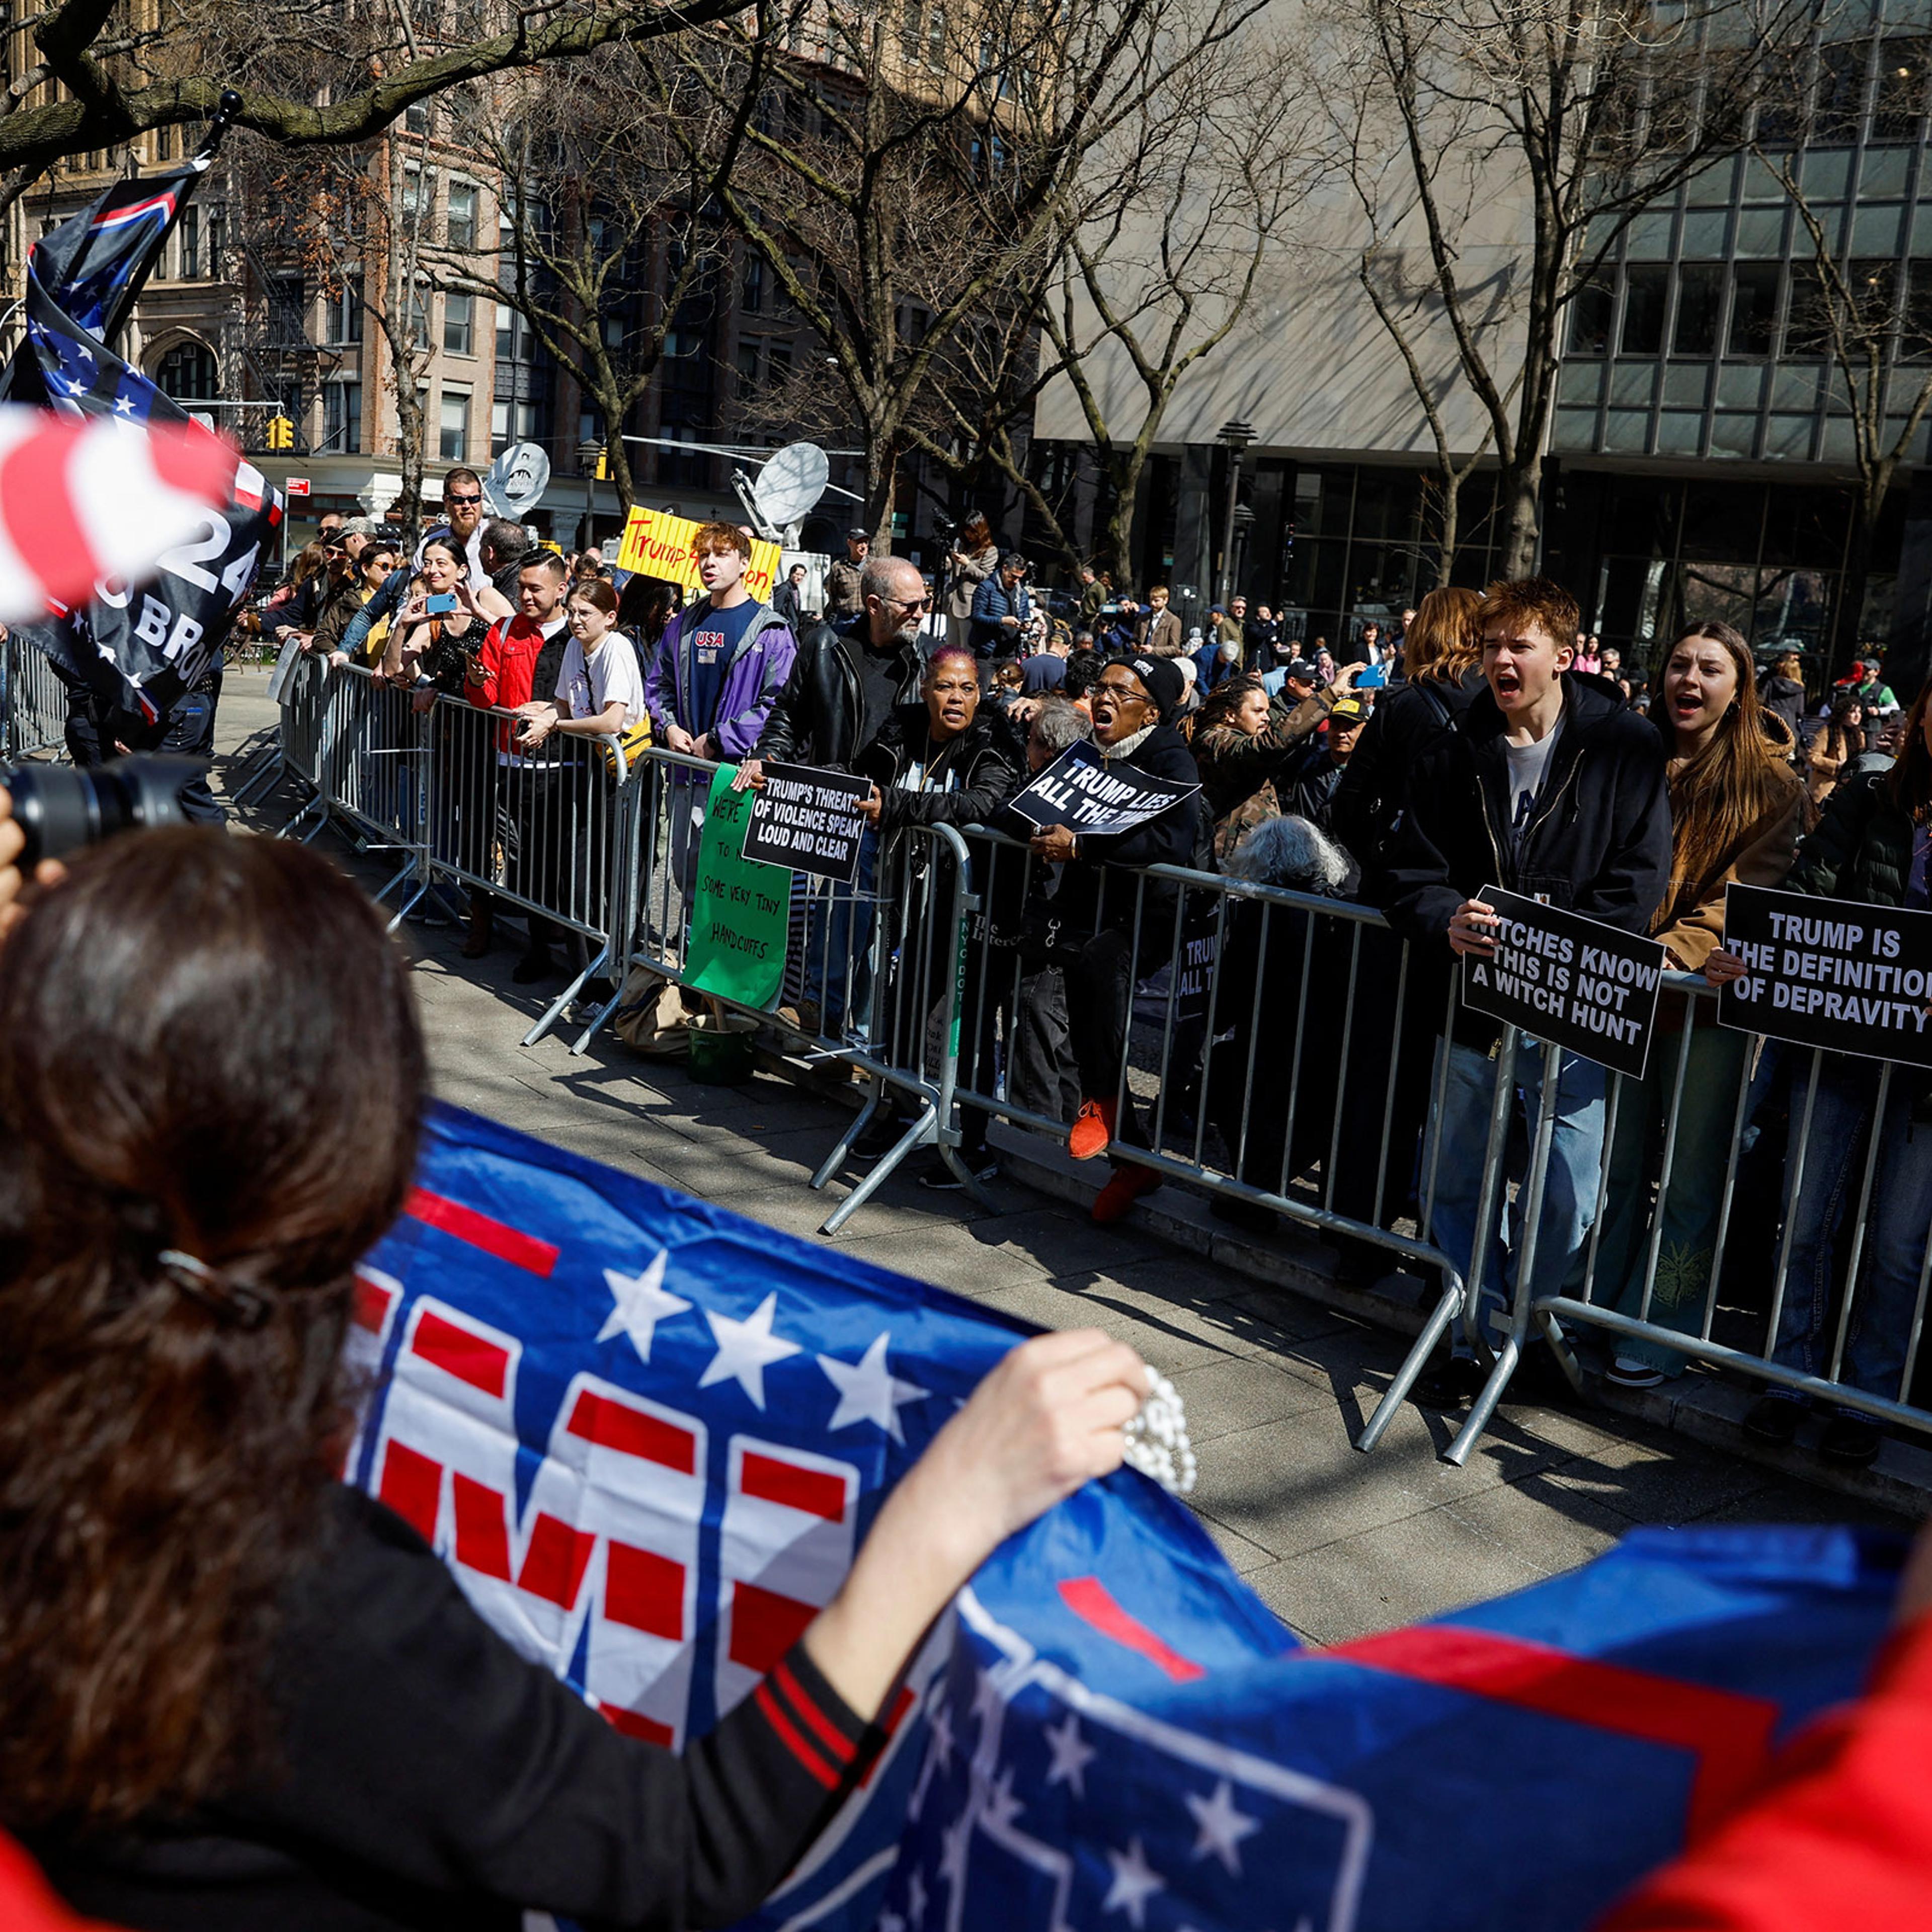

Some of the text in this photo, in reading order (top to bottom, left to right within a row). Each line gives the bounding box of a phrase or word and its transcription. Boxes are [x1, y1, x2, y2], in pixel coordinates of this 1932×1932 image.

[629, 520, 686, 568] Trump
[695, 631, 725, 648] USA
[766, 778, 860, 814] TRUMP'S THREATS
[1029, 775, 1075, 812] ALL
[1072, 797, 1119, 825] THE
[1063, 758, 1177, 809] TRUMP LIES
[754, 798, 862, 839] OF VIOLENCE SPEAK
[757, 823, 849, 861] LOUD AND CLEAR
[717, 842, 729, 857] TO
[701, 875, 780, 916] SOME VERY TINY
[711, 923, 768, 959] HANDCUFFS
[1769, 911, 1901, 958] TRUMP IS
[1180, 969, 1202, 997] ALL
[1491, 944, 1630, 1011] THIS IS NOT
[1580, 945, 1659, 992] KNOW
[1726, 938, 1932, 999] THE DEFINITIO
[1472, 963, 1643, 1045] A WITCH HUNT
[1733, 976, 1928, 1033] OF DEPRAVITY
